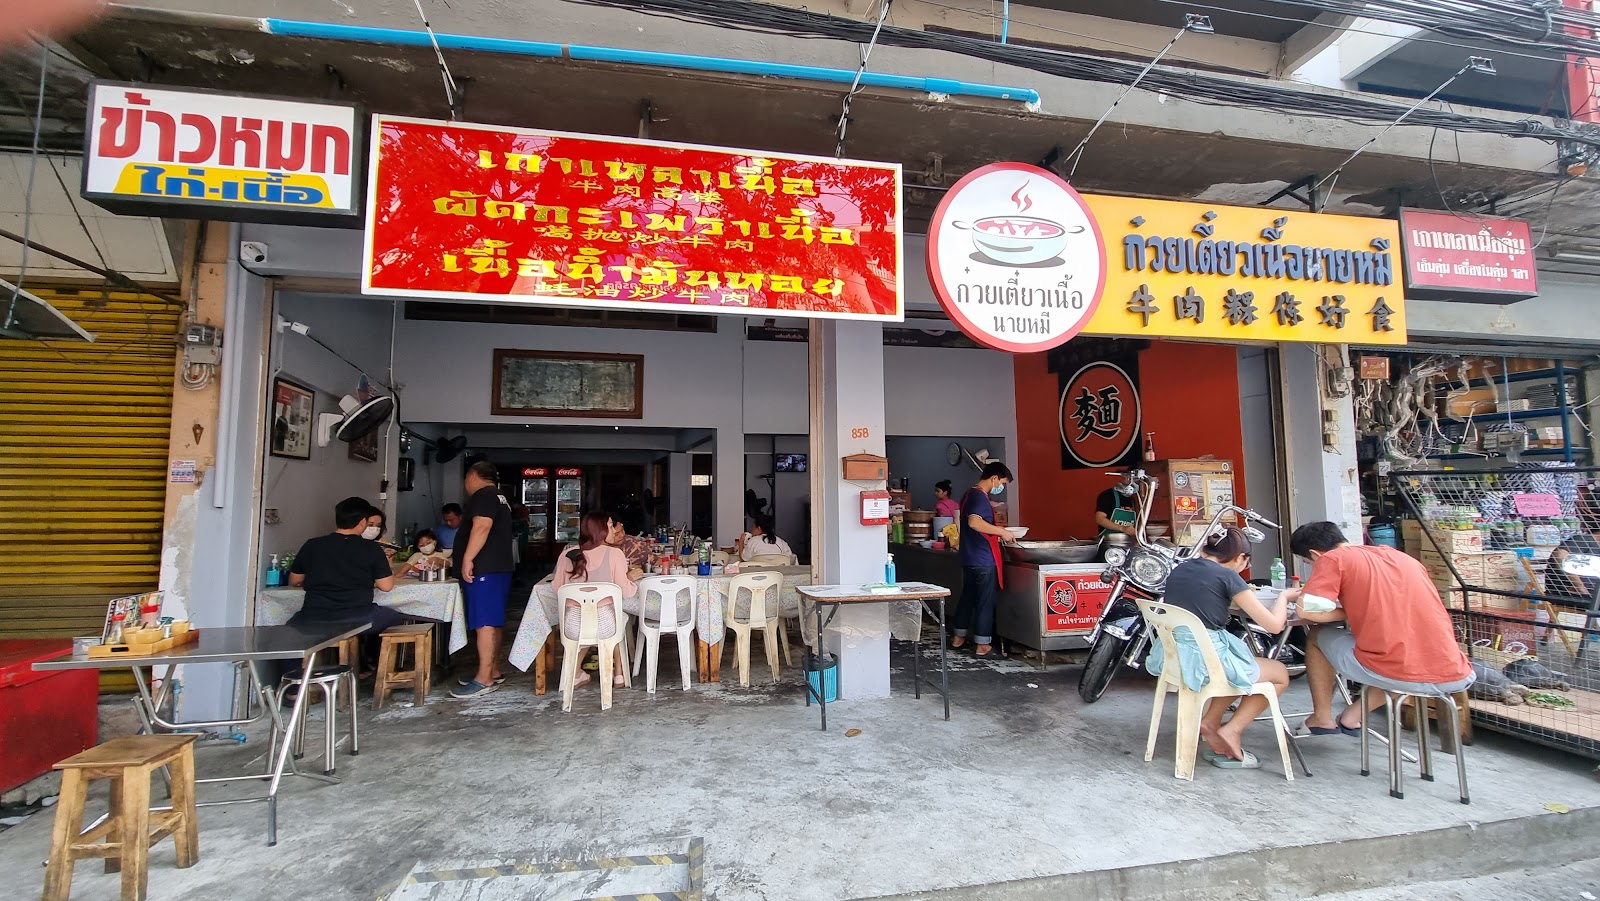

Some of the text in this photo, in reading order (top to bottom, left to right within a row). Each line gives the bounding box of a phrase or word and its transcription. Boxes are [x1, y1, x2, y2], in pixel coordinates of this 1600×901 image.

[98, 92, 350, 175] ข้าวหมก
[477, 150, 819, 197] เกาเหลาเนื้อ
[441, 239, 845, 296] เนื้อน้ำมันหอย
[957, 266, 1083, 310] ก๋วยเตี๋ยวเนื้อ
[993, 311, 1050, 334] นายหมี
[851, 427, 869, 439] 858
